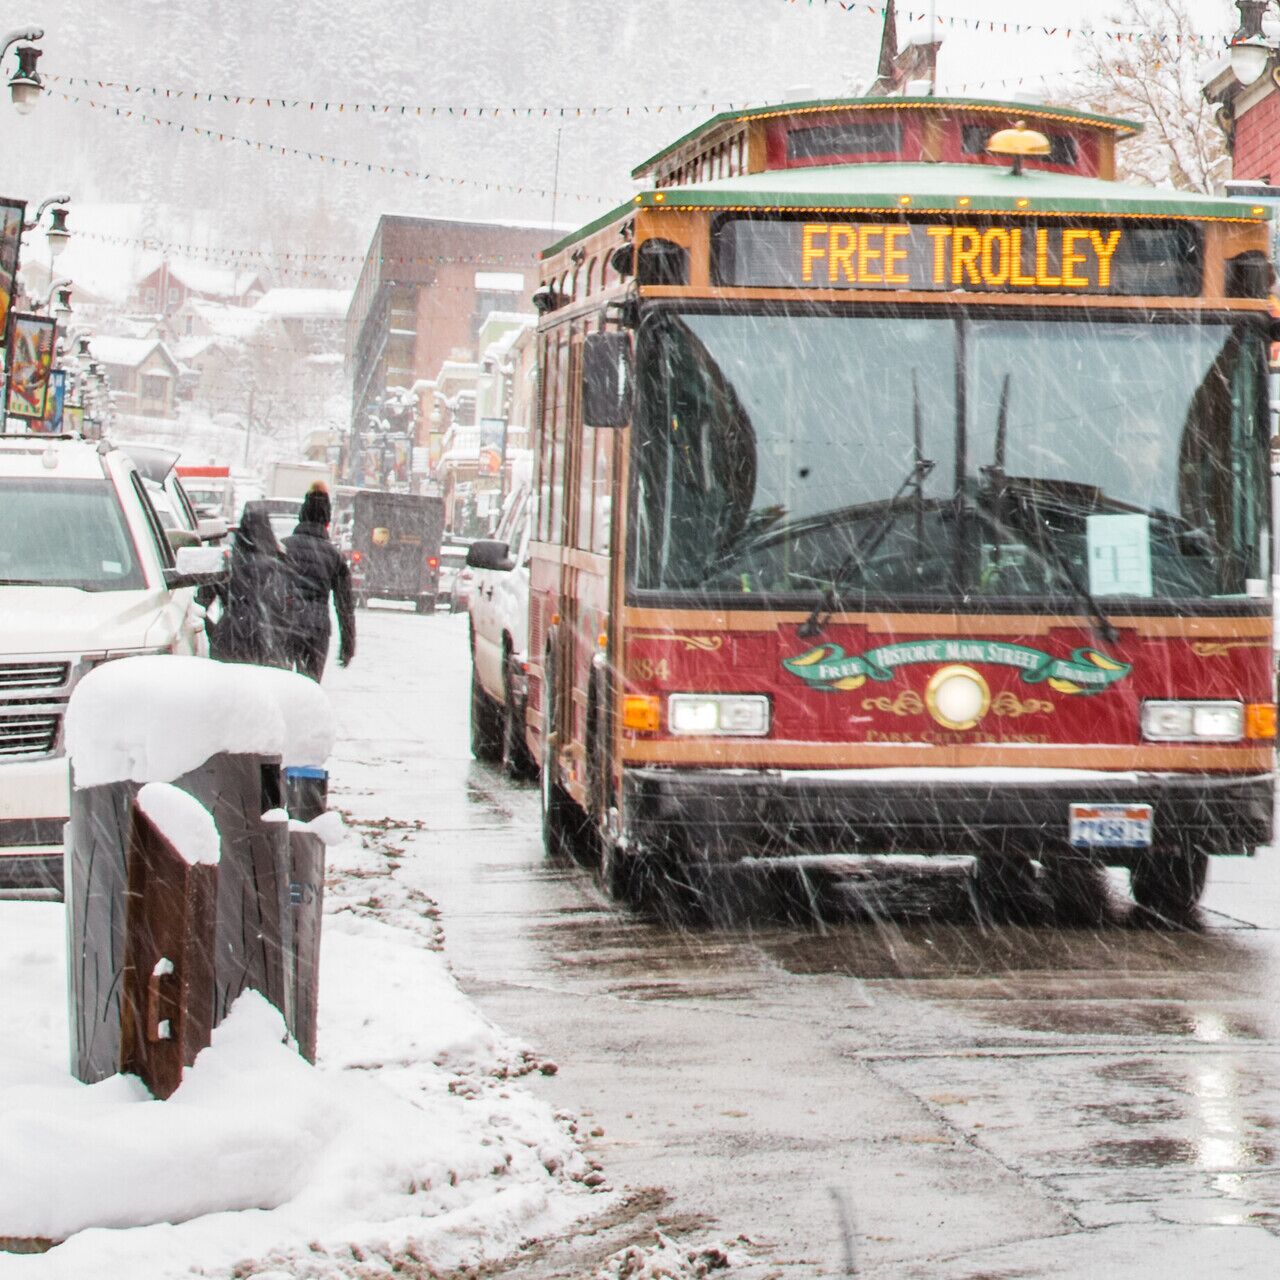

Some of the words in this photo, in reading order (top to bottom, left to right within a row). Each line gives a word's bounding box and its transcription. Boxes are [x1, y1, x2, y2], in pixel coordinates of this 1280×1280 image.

[801, 223, 911, 283] FREE
[926, 226, 1122, 288] TROLLEY
[819, 662, 861, 679] FREE
[876, 642, 941, 667] HISTORIC
[945, 641, 984, 661] MAIN
[987, 642, 1041, 670] STREET
